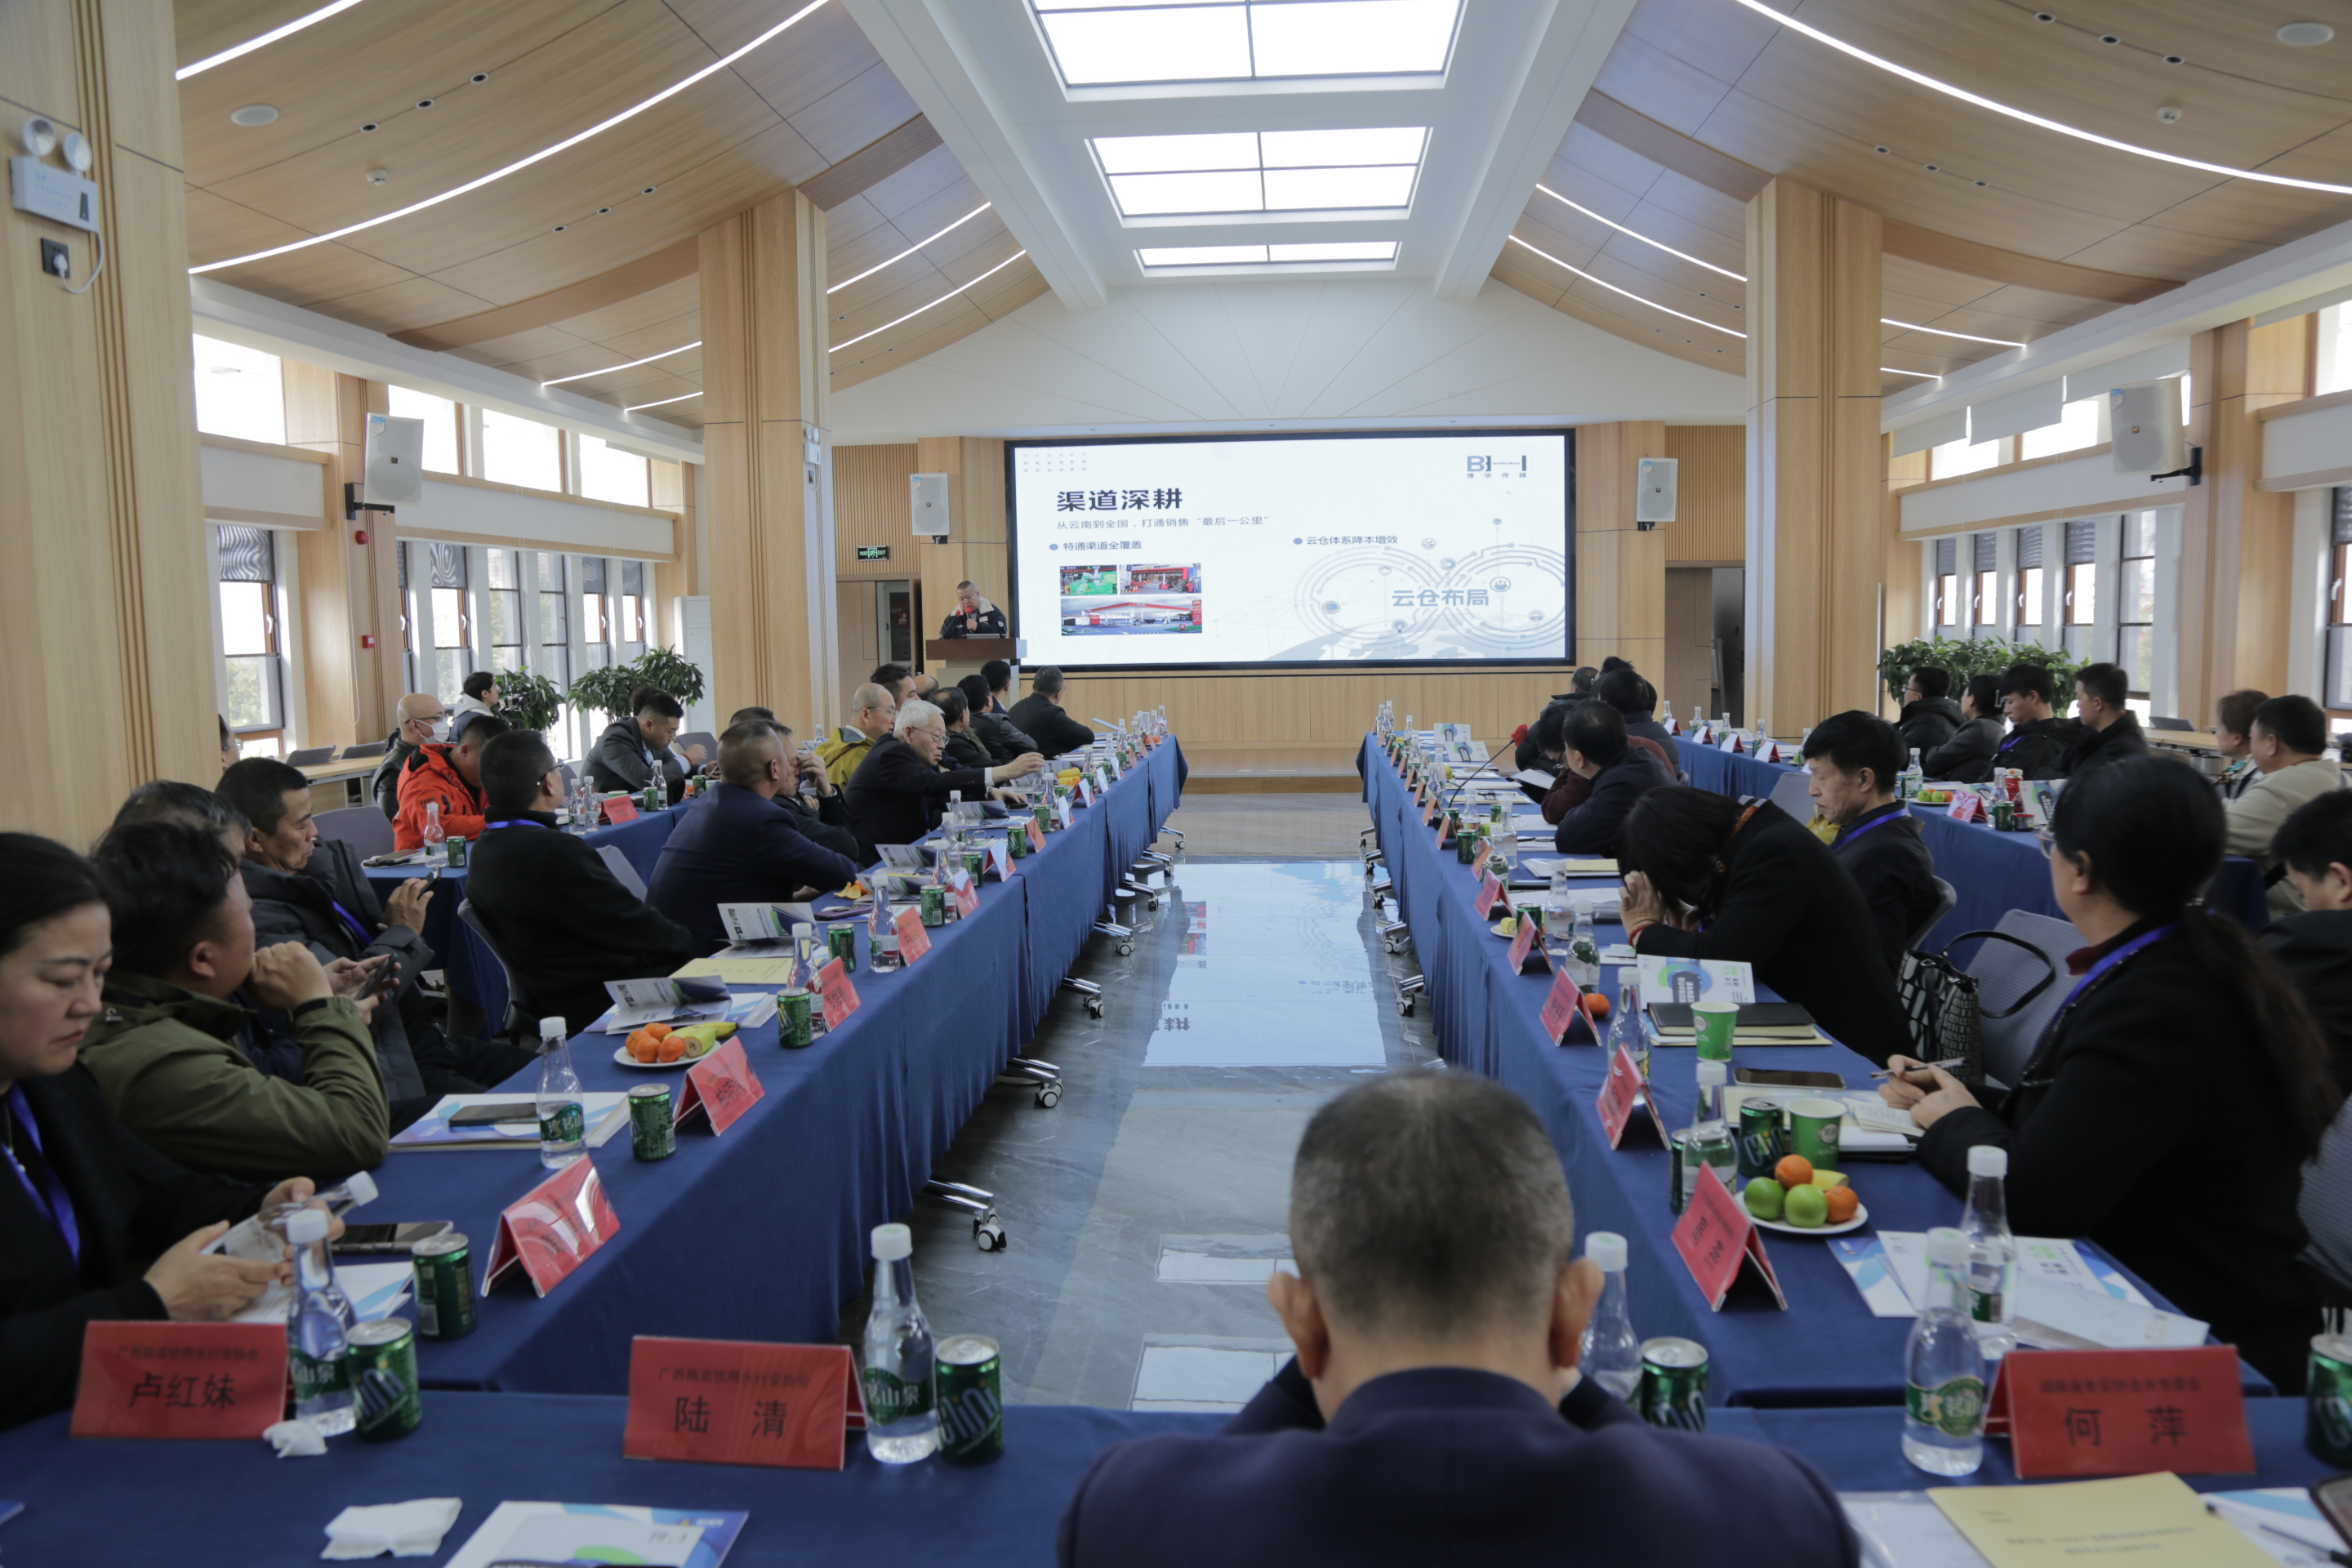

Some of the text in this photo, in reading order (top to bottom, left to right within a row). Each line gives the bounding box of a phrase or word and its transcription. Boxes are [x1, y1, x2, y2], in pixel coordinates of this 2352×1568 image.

[1057, 488, 1183, 512] 渠道深耕
[1062, 541, 1142, 551] 特通渠道全覆盖
[1306, 535, 1398, 545] 云仓体系降本增效
[1392, 588, 1490, 607] 云仓布局
